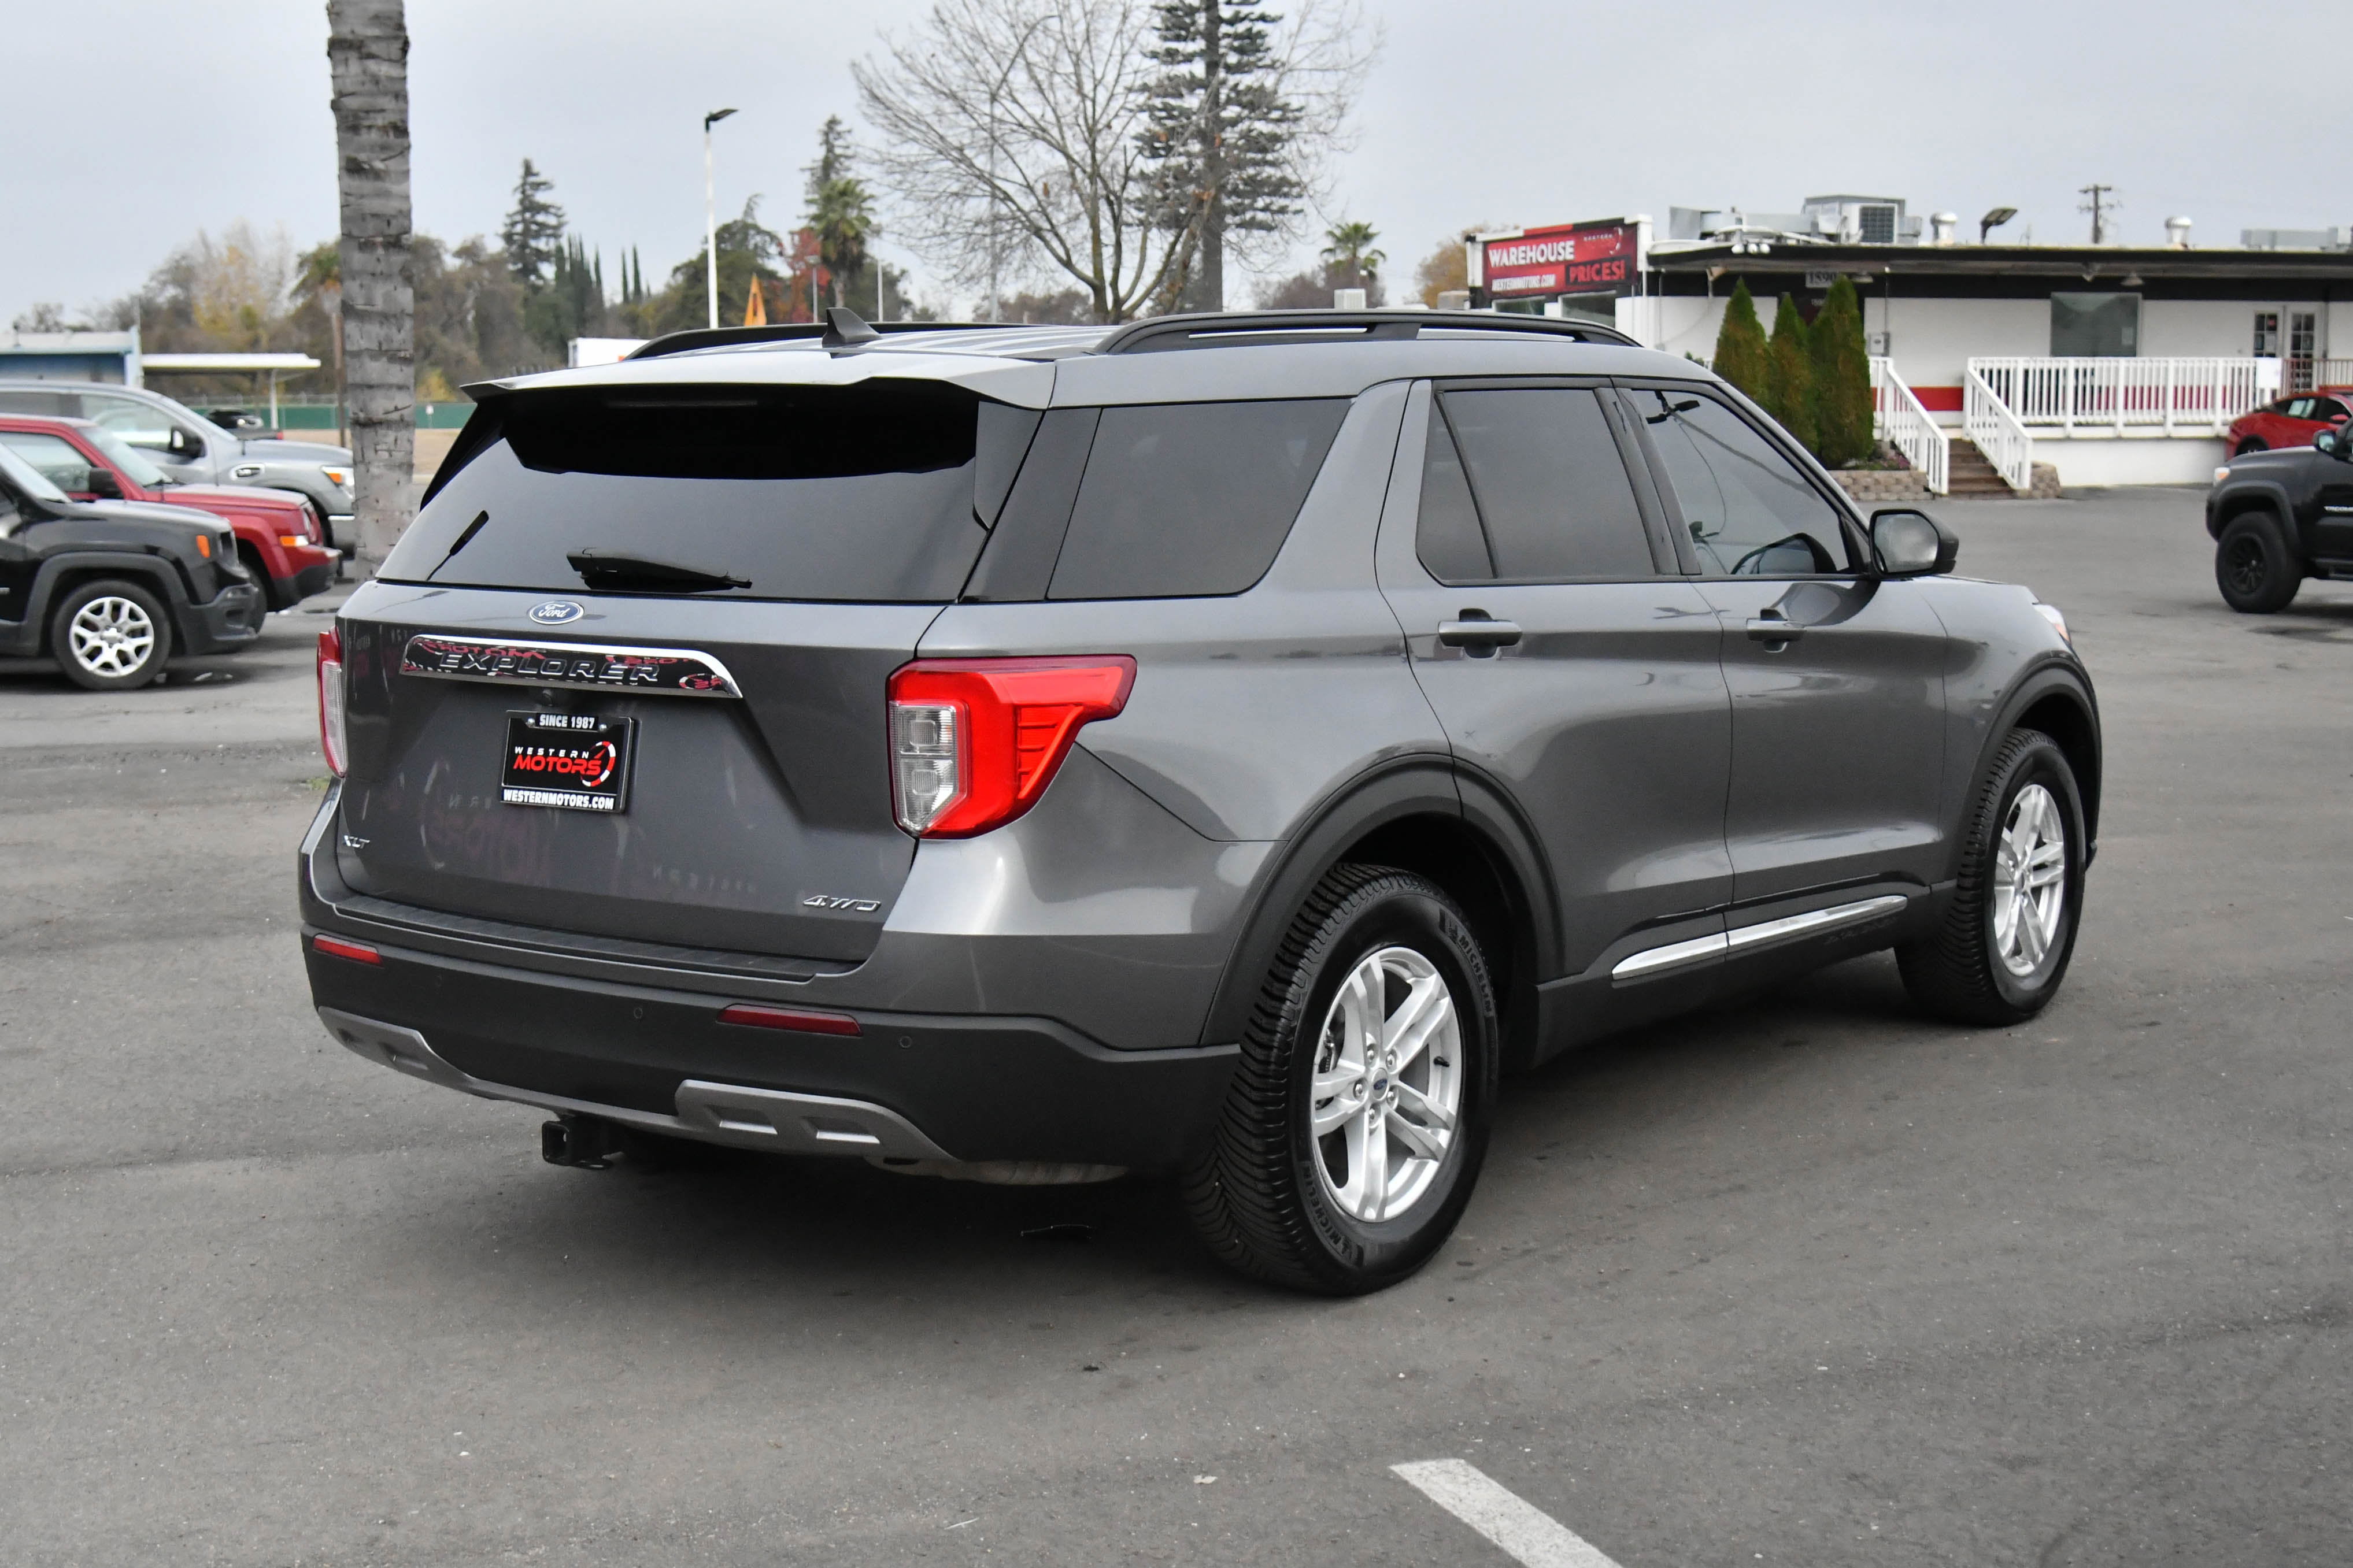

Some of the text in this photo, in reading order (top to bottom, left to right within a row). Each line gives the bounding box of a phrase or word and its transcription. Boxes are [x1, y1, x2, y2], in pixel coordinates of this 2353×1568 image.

[1489, 240, 1575, 268] WAREHOUSE
[538, 603, 571, 618] Ford
[439, 652, 660, 682] EXPLORER
[539, 714, 595, 729] SINCE 1987
[515, 746, 589, 759] WESTERN
[513, 755, 602, 775] MOTORS
[504, 789, 614, 809] WESTERNMOTORS.COM
[343, 835, 370, 849] XLT
[803, 895, 881, 911] 4WD
[1459, 935, 1492, 1013] MICHELIN
[1303, 1166, 1341, 1245] MICHELIN
